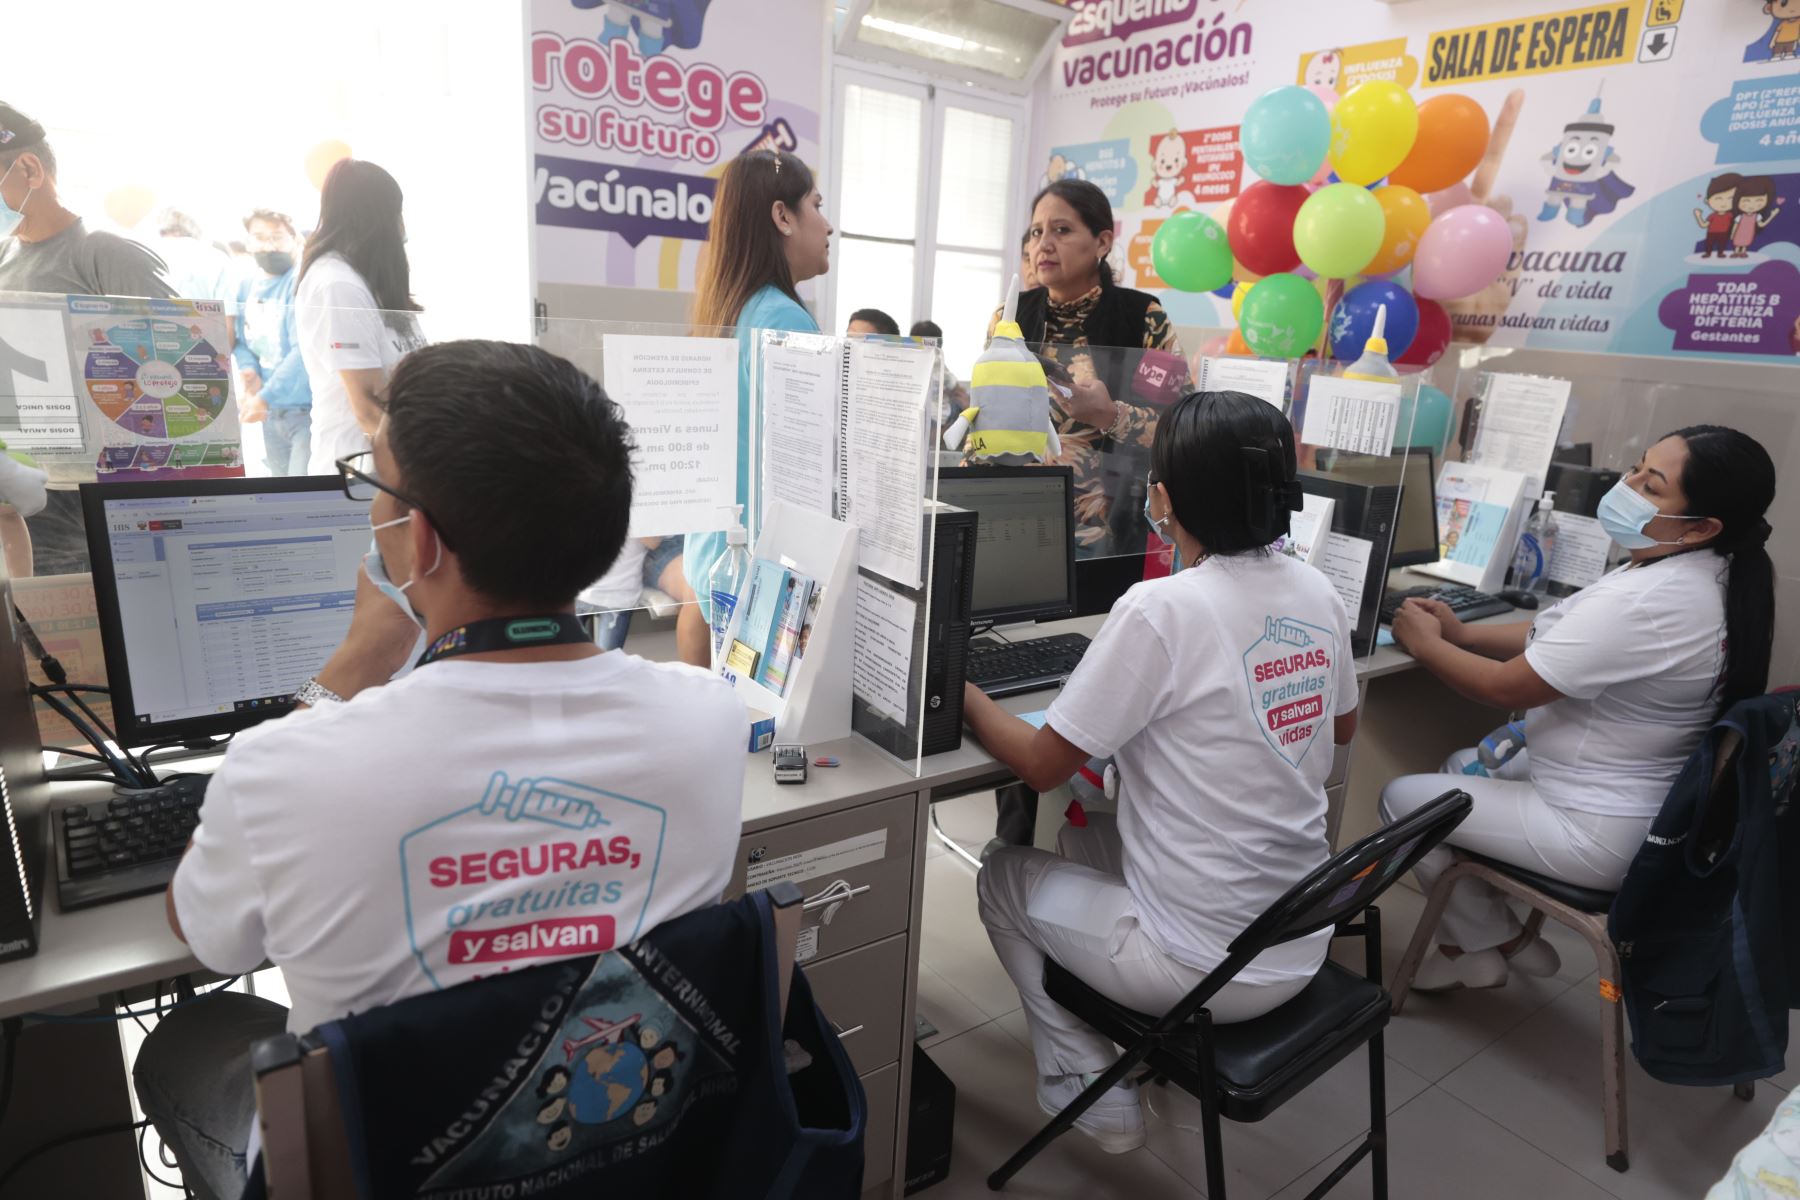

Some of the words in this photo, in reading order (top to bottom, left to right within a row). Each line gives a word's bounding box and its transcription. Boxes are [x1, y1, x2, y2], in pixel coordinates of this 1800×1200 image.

[1064, 12, 1252, 87] vacunación
[1429, 30, 1487, 81] SALA
[1489, 24, 1524, 73] DE
[1525, 7, 1629, 69] ESPERA
[532, 36, 764, 130] rotege
[1090, 92, 1128, 109] Protege
[1130, 93, 1142, 104] su
[1731, 107, 1795, 121] INFLUENZA
[543, 110, 587, 142] su
[599, 111, 715, 159] futuro
[1506, 250, 1626, 273] vacuna
[1538, 280, 1562, 298] de
[1565, 281, 1612, 300] vida
[1717, 282, 1758, 293] TDAP
[1689, 293, 1767, 306] HEPATITIS
[1768, 294, 1781, 306] B
[1689, 305, 1774, 317] INFLUENZA
[1451, 313, 1495, 327] cunas
[1498, 313, 1556, 331] salvan
[1560, 314, 1610, 333] vidas
[1694, 316, 1762, 328] DIFTERIA
[1691, 330, 1760, 343] Gestantes
[1254, 649, 1330, 682] SEGURAS,
[1262, 674, 1326, 710] gratuitas
[1271, 713, 1279, 728] y
[1281, 700, 1319, 721] salvan
[1278, 725, 1313, 746] vidas
[428, 836, 642, 888] SEGURAS,
[445, 879, 623, 933] gratuitas
[462, 938, 486, 961] y
[491, 924, 599, 953] salvan
